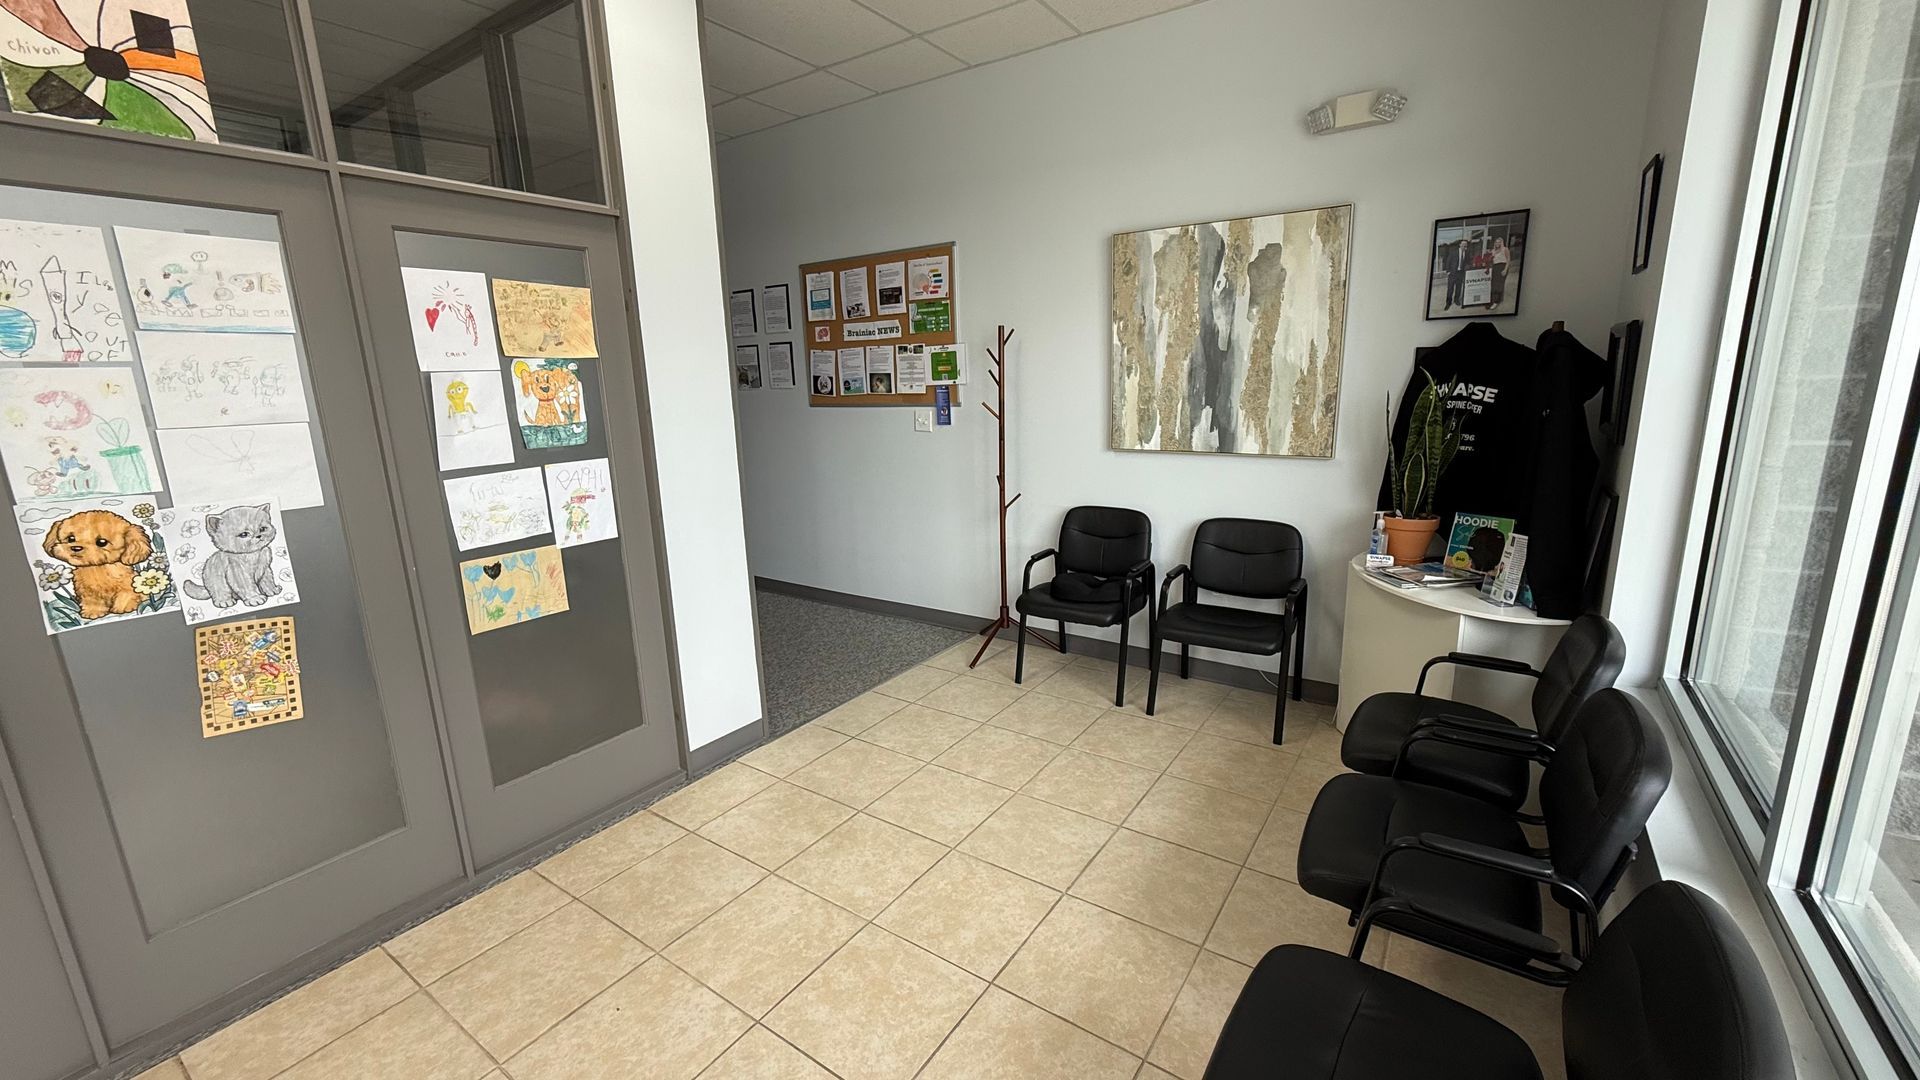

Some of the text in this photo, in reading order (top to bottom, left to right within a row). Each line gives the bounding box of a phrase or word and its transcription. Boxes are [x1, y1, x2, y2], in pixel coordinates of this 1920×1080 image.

[847, 326, 900, 337] Brainiac NEWS
[1429, 382, 1499, 403] YNAPSE
[1455, 515, 1499, 529] HOODIE
